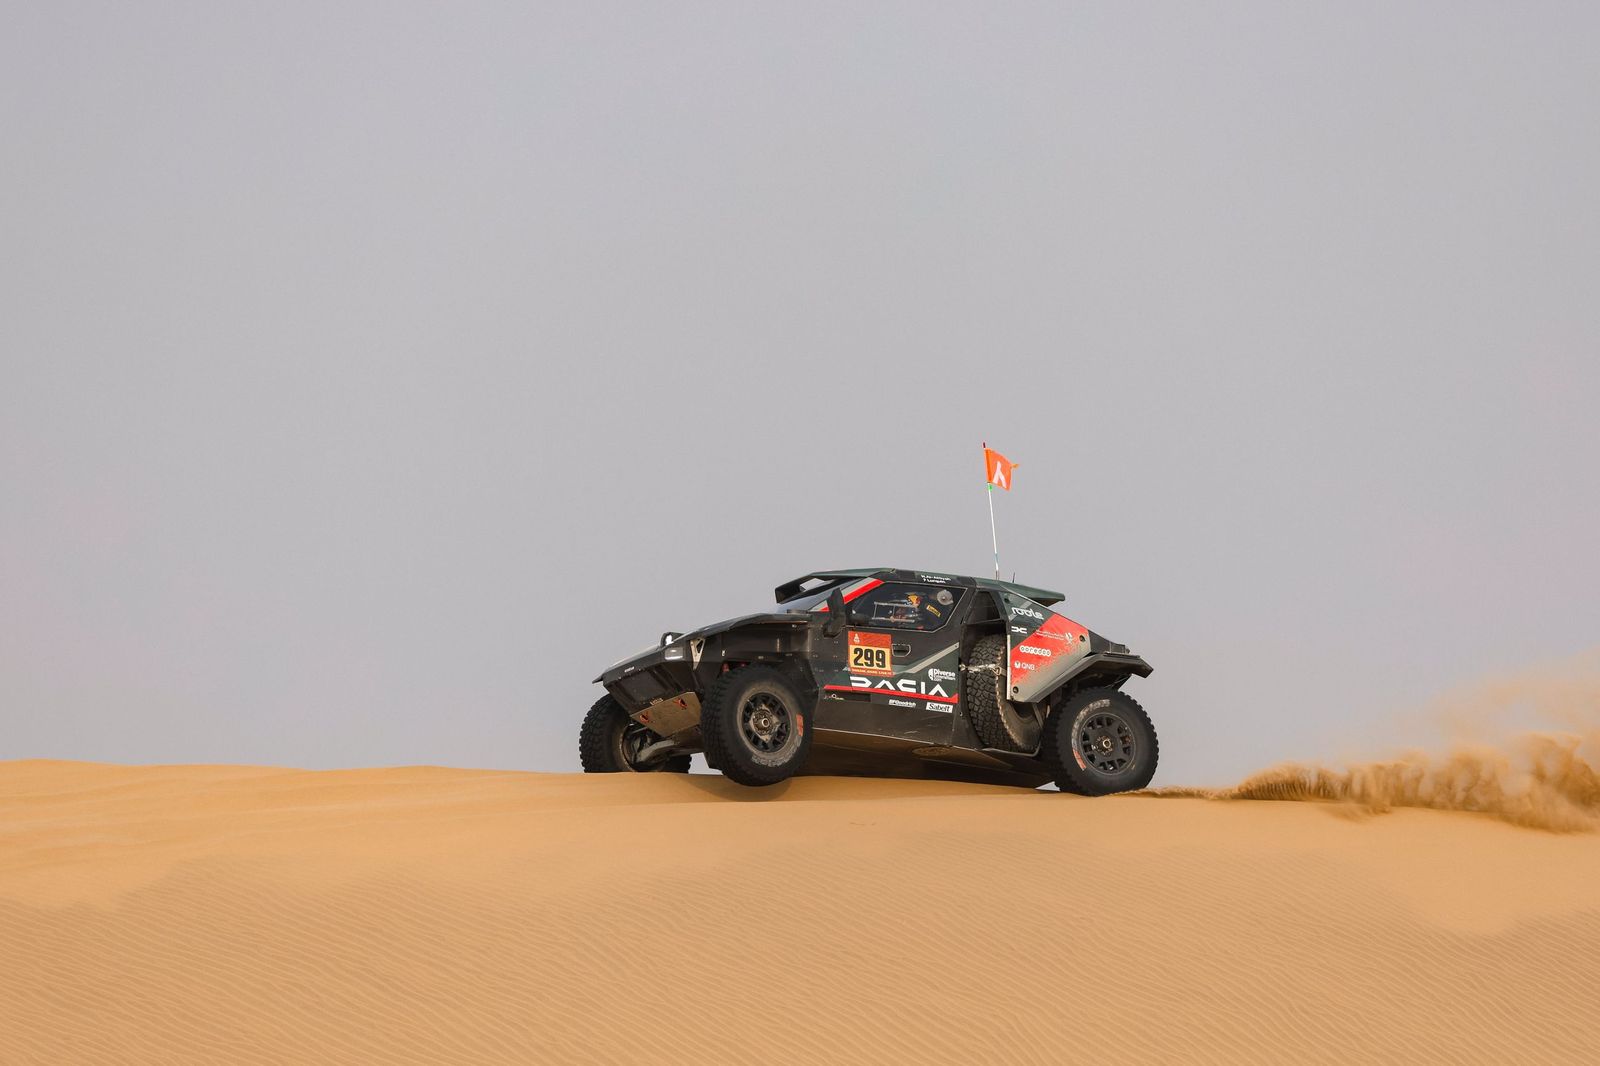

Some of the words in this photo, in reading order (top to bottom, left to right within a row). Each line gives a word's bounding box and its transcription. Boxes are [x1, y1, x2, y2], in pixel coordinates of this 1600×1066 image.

[853, 647, 886, 668] 299
[934, 669, 956, 678] Diverse
[850, 676, 949, 698] DACIA
[928, 703, 951, 712] Sabelt
